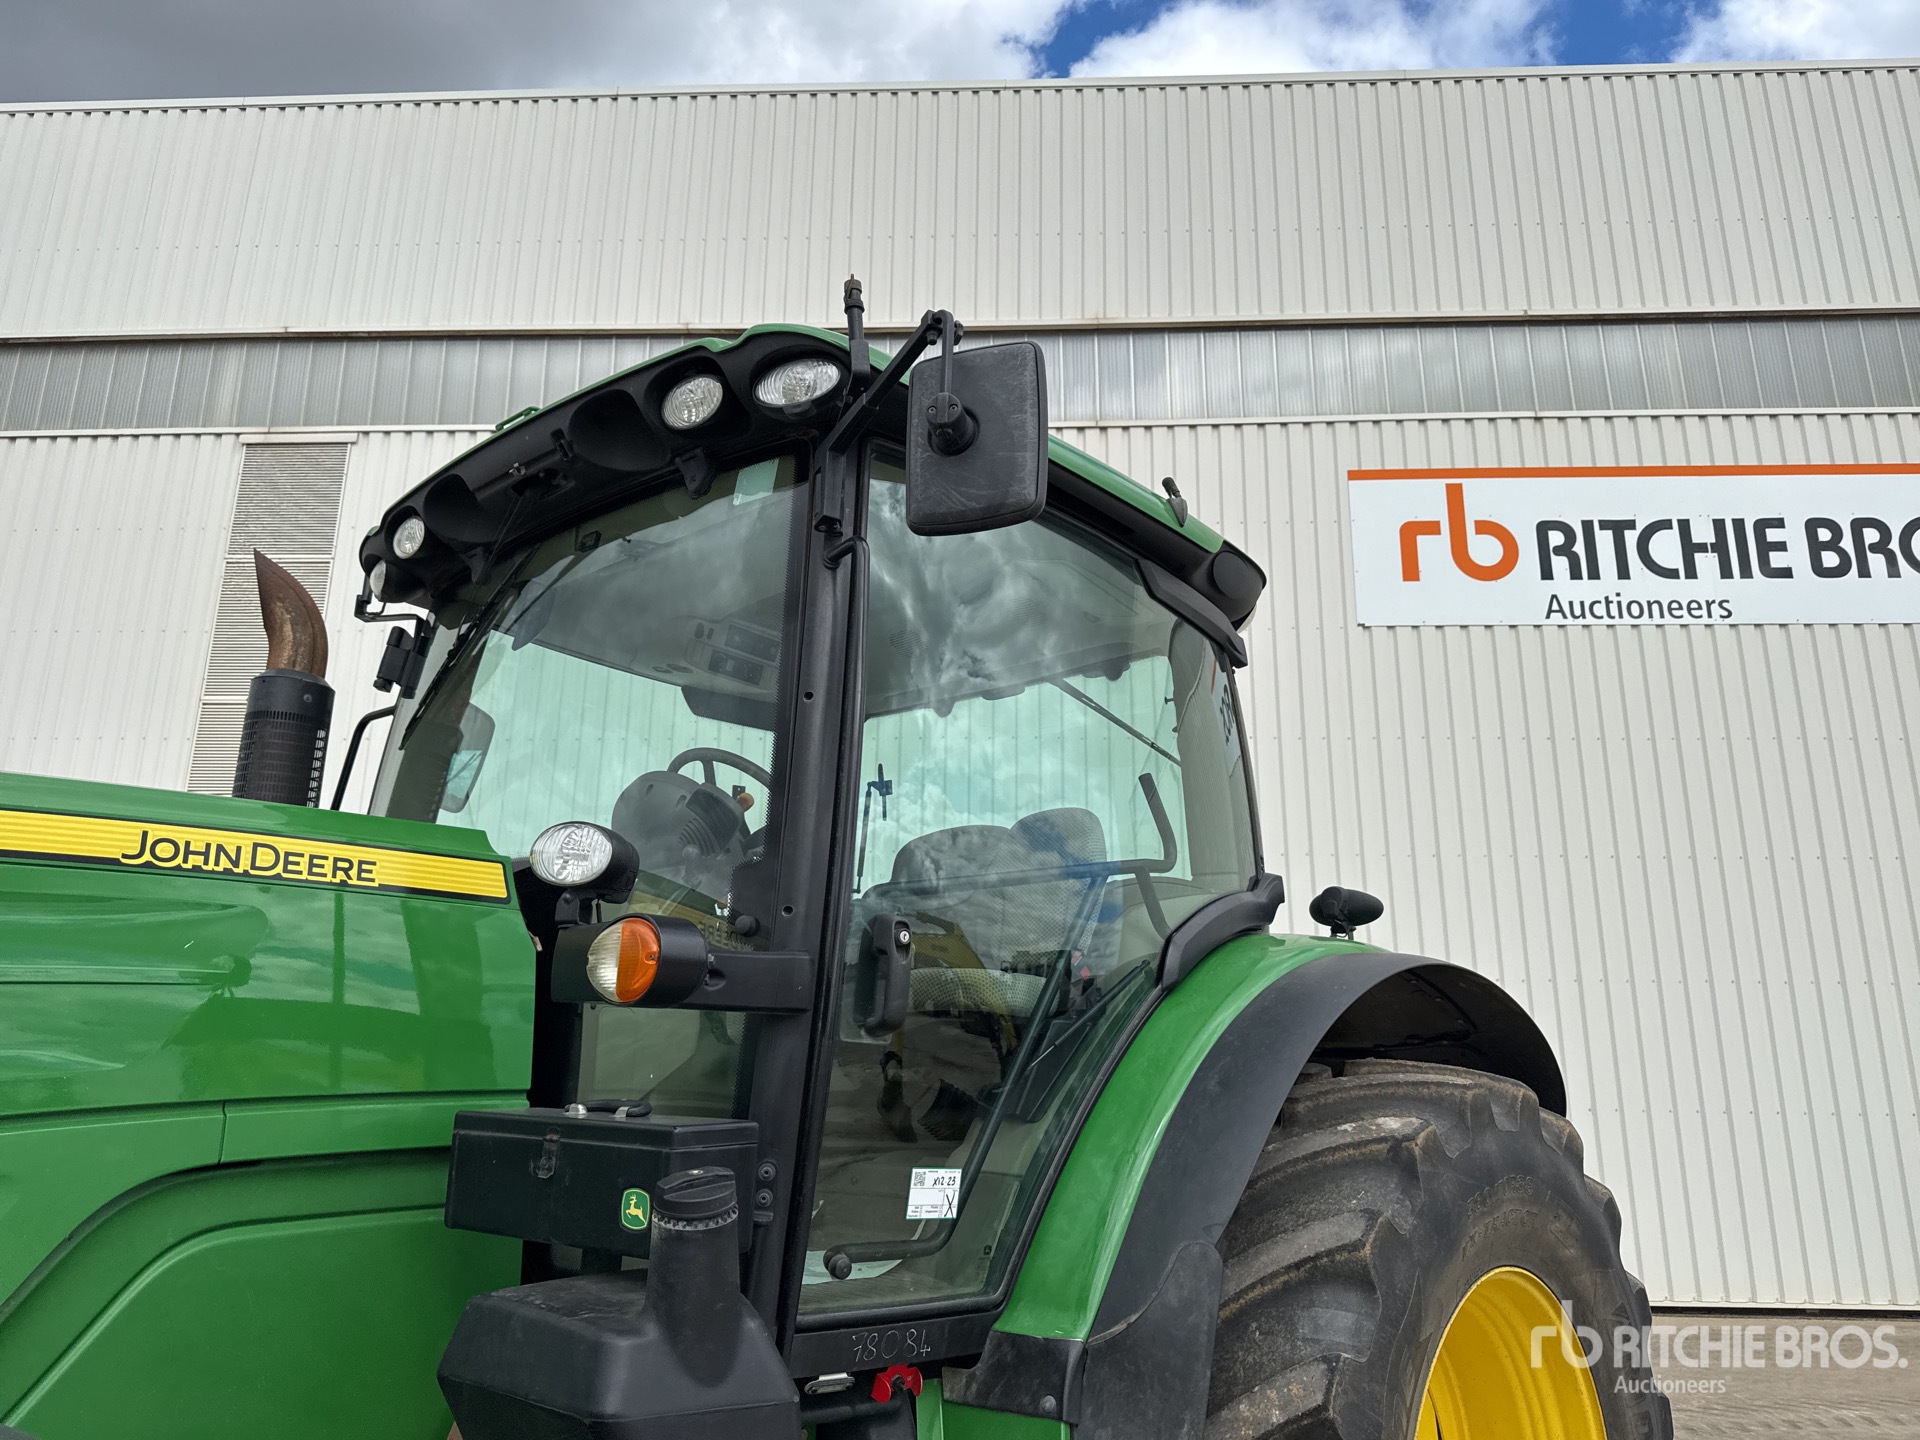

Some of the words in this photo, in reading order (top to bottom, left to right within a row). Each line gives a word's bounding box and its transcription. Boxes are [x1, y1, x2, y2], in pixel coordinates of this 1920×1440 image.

[1535, 516, 1794, 581] RITCHIE
[1545, 592, 1733, 620] Auctioneers
[120, 829, 242, 870] JOHN
[249, 841, 378, 883] DEERE
[852, 1328, 932, 1362] 78084
